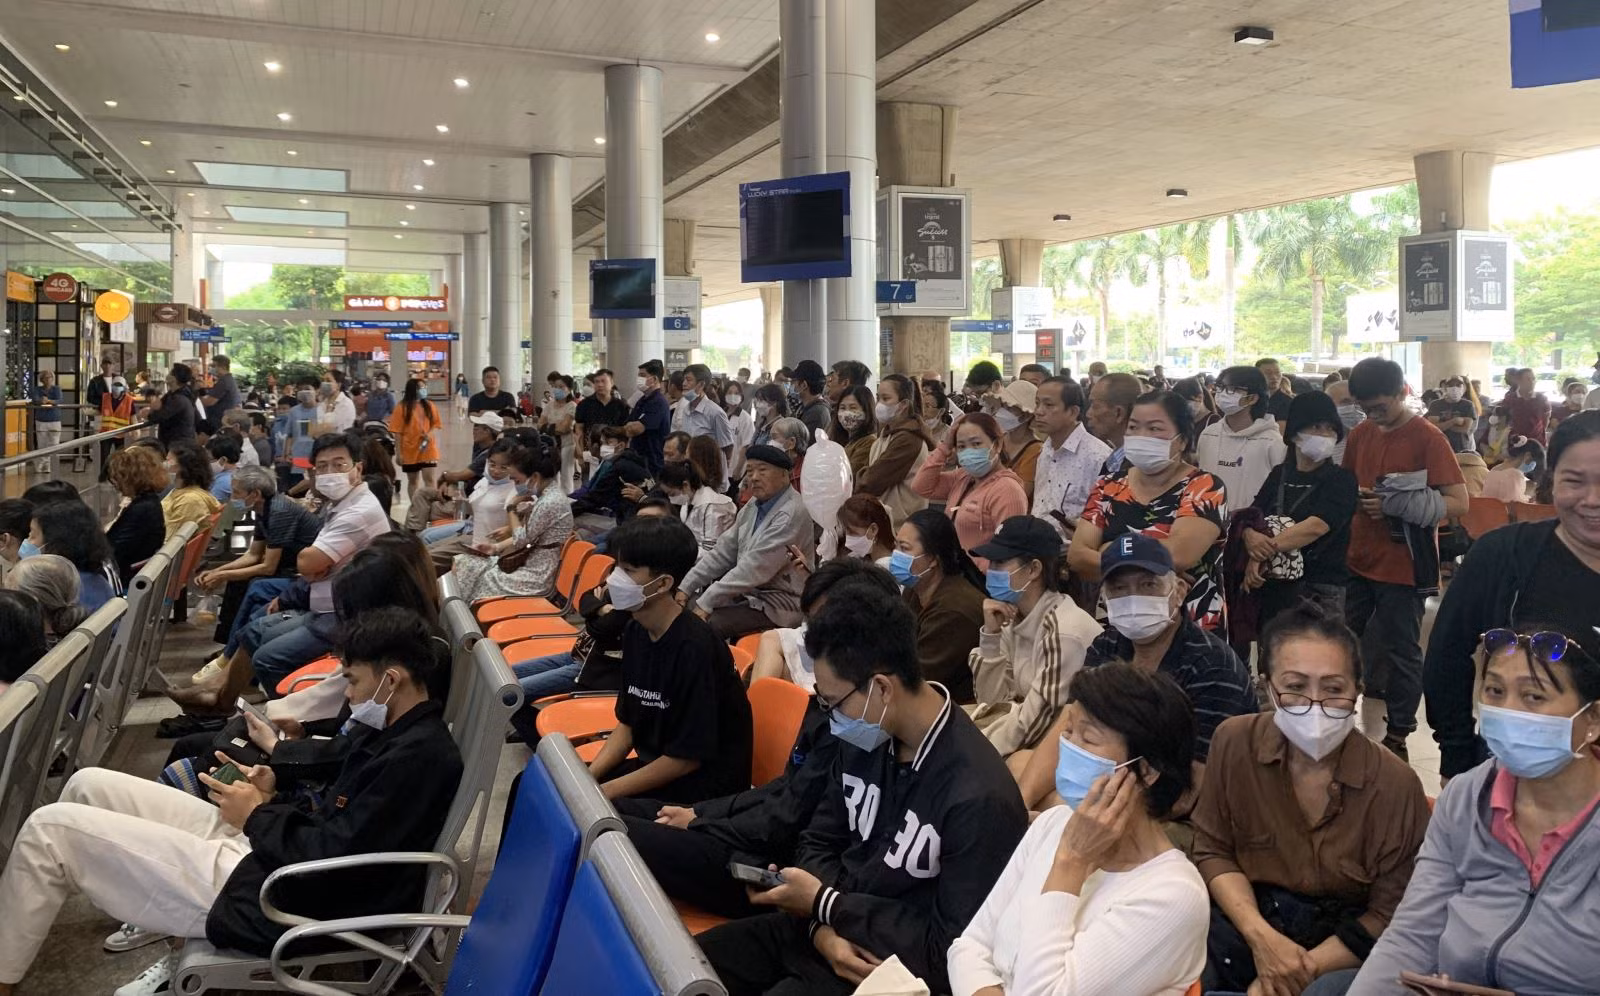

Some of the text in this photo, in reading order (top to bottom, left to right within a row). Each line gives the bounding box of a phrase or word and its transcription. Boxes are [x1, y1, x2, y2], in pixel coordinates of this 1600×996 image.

[50, 278, 69, 287] 4G
[890, 283, 901, 300] 7
[674, 318, 682, 329] 6
[579, 333, 586, 341] 5
[1121, 537, 1133, 556] E
